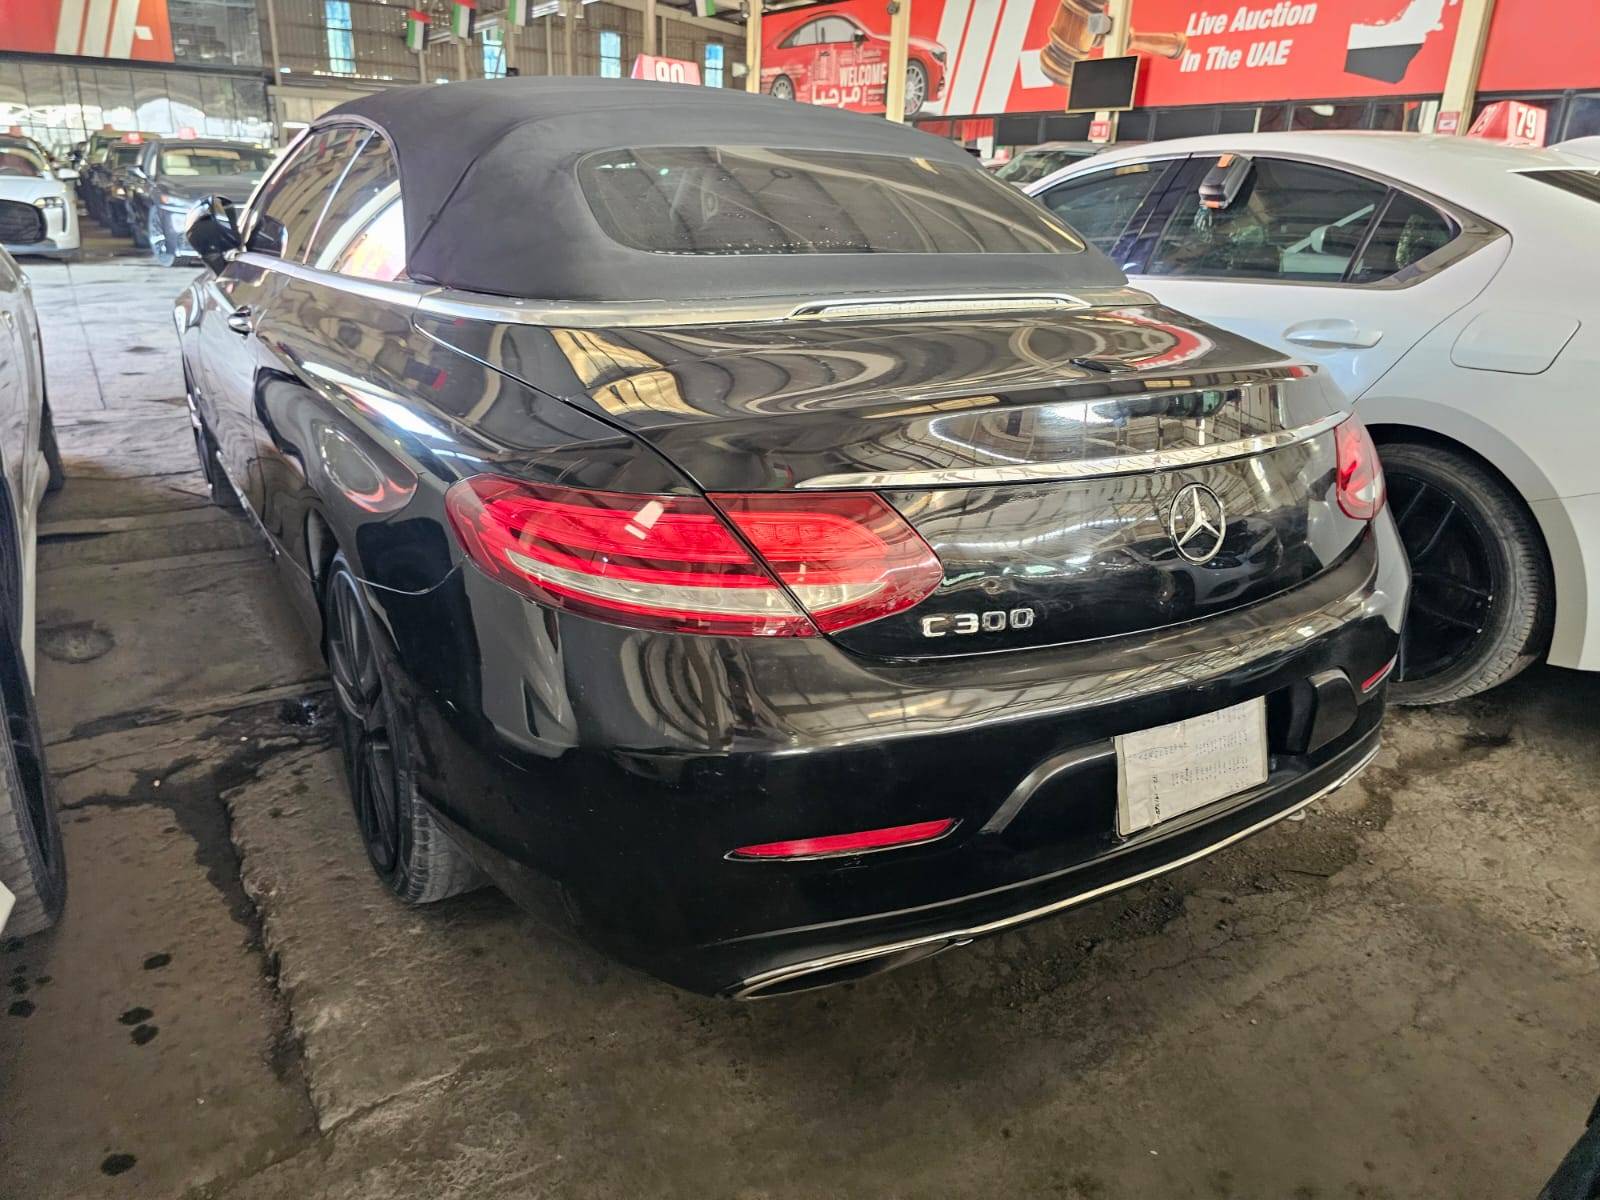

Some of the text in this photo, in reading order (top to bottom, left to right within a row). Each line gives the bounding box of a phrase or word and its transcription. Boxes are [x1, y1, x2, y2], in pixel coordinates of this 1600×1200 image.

[1185, 1, 1318, 37] Live Auction
[1180, 39, 1293, 73] In The UAE
[839, 63, 887, 87] WELCOME
[812, 84, 862, 108] مرحبا
[1516, 107, 1537, 139] 79
